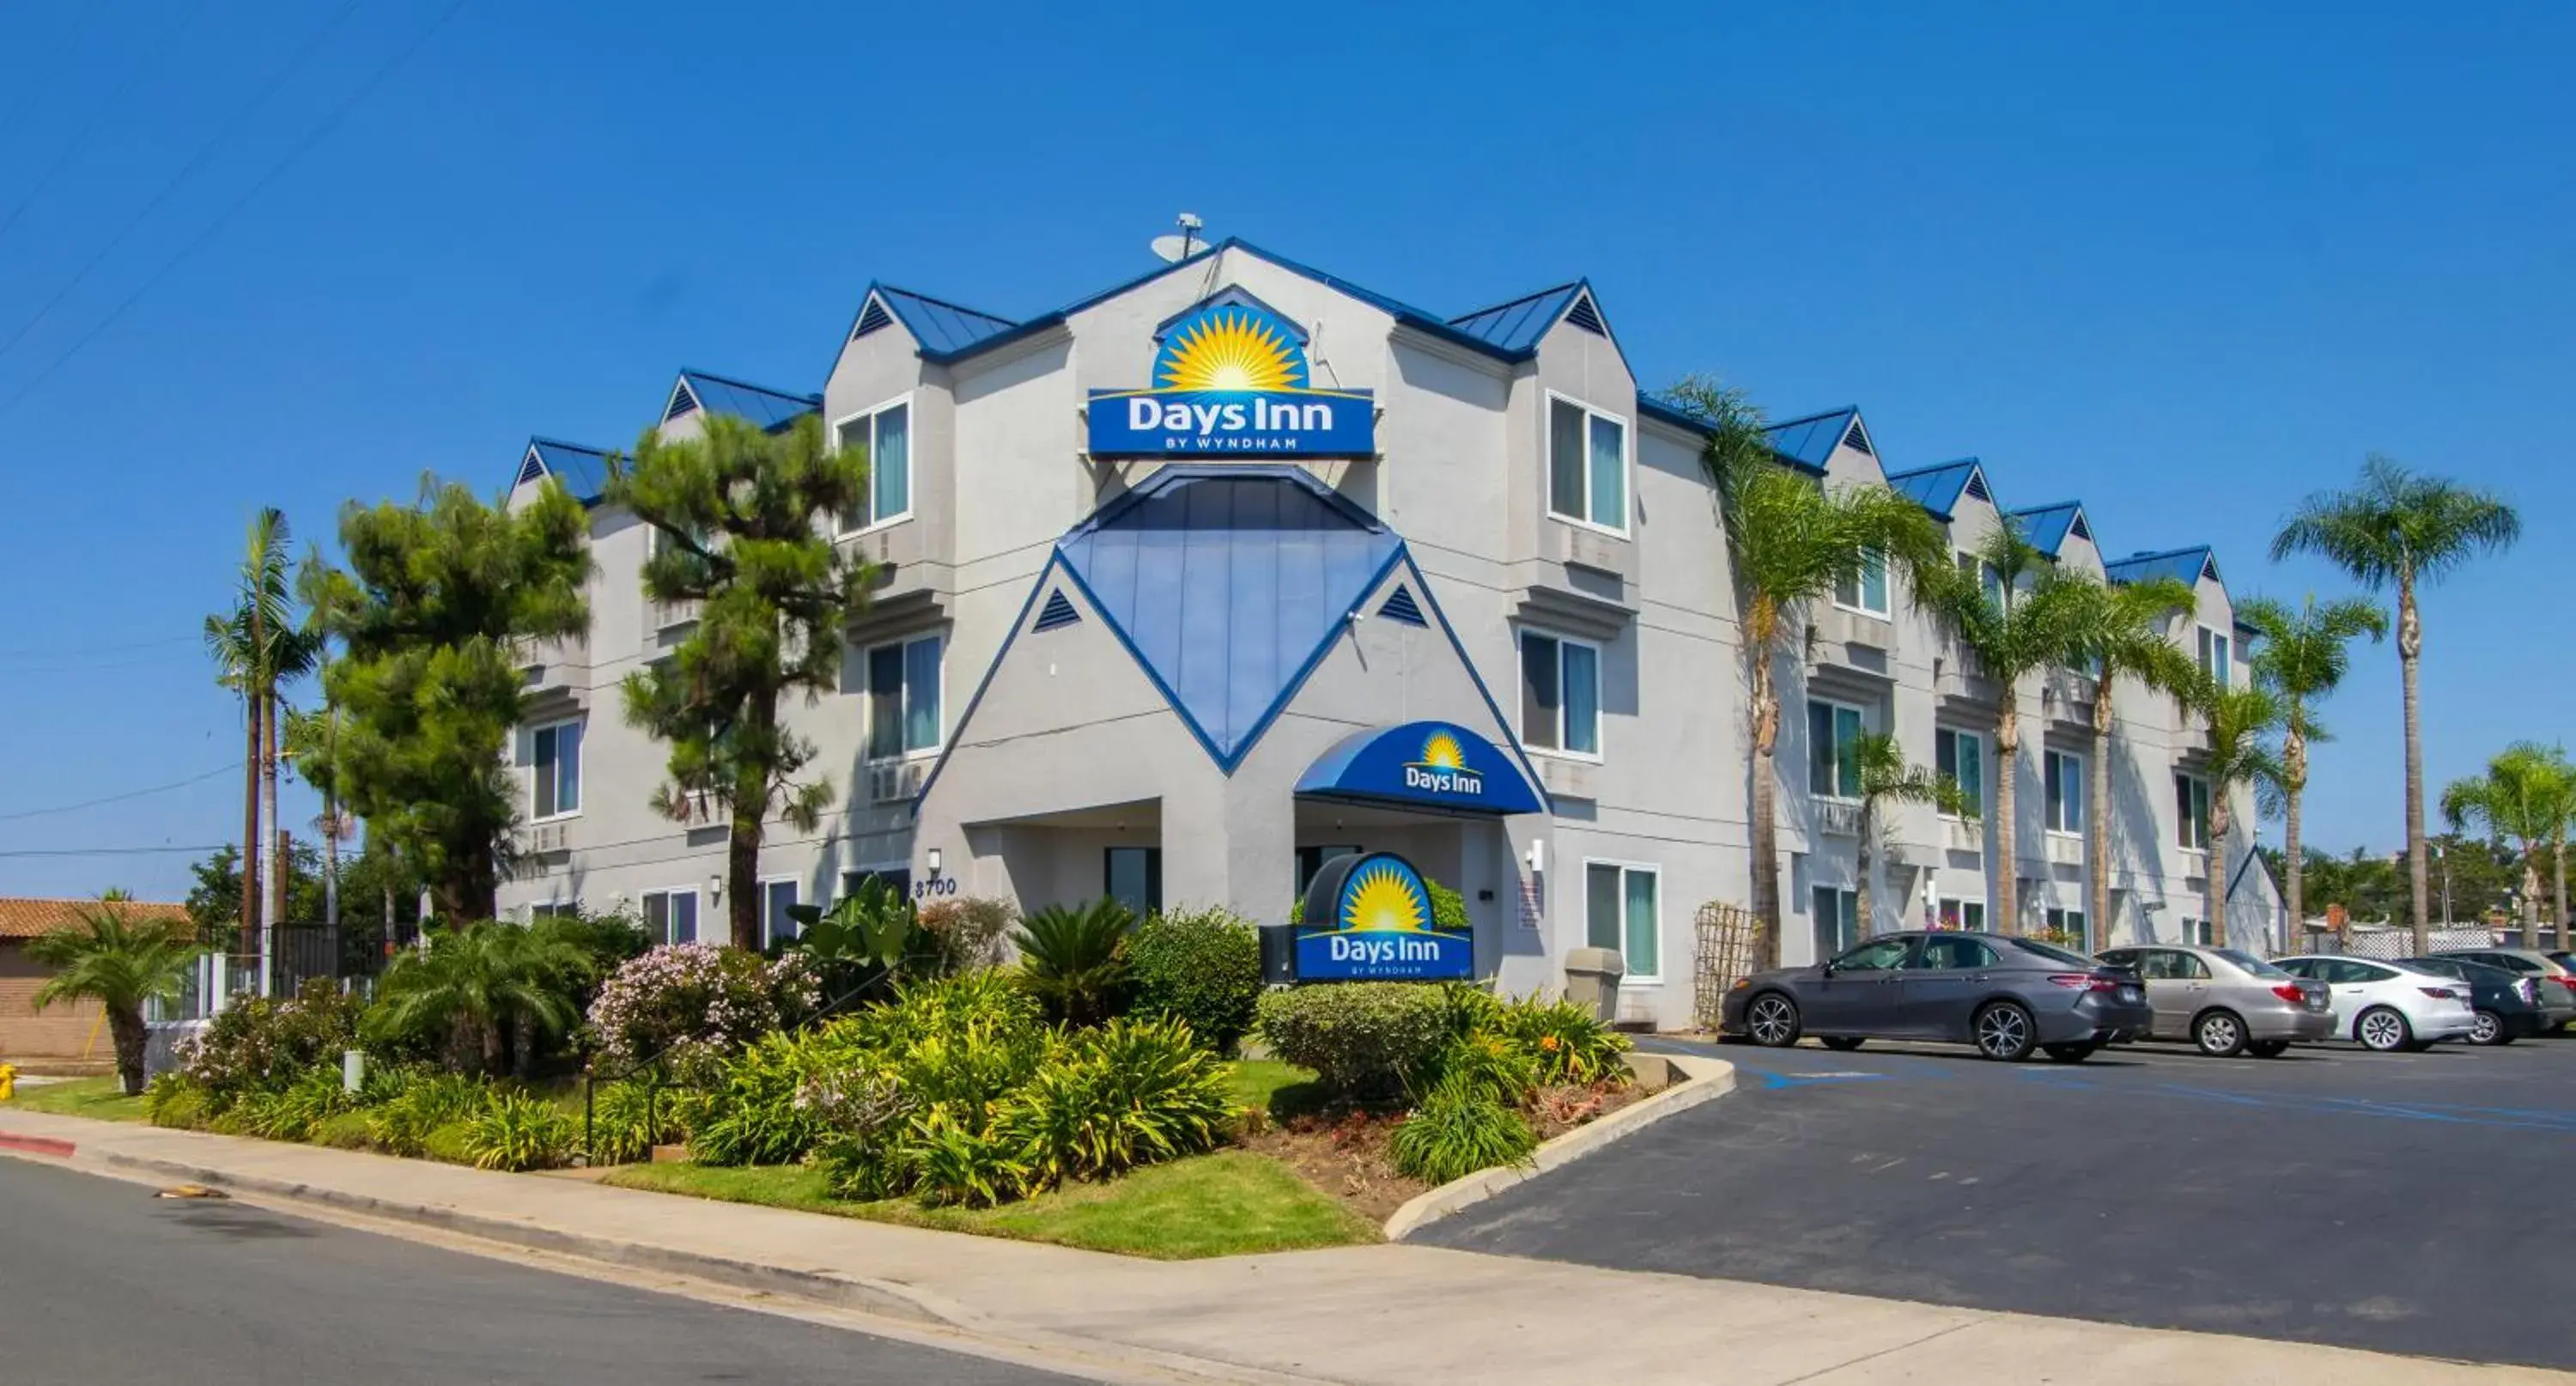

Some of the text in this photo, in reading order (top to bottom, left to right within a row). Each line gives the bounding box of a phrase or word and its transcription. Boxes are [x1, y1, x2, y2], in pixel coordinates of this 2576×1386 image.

[1129, 398, 1333, 435] Days Inn
[1166, 437, 1297, 449] BY WYNDHAM
[1406, 767, 1481, 794] Days Inn
[915, 878, 956, 899] 8700
[1331, 935, 1440, 964] Days Inn
